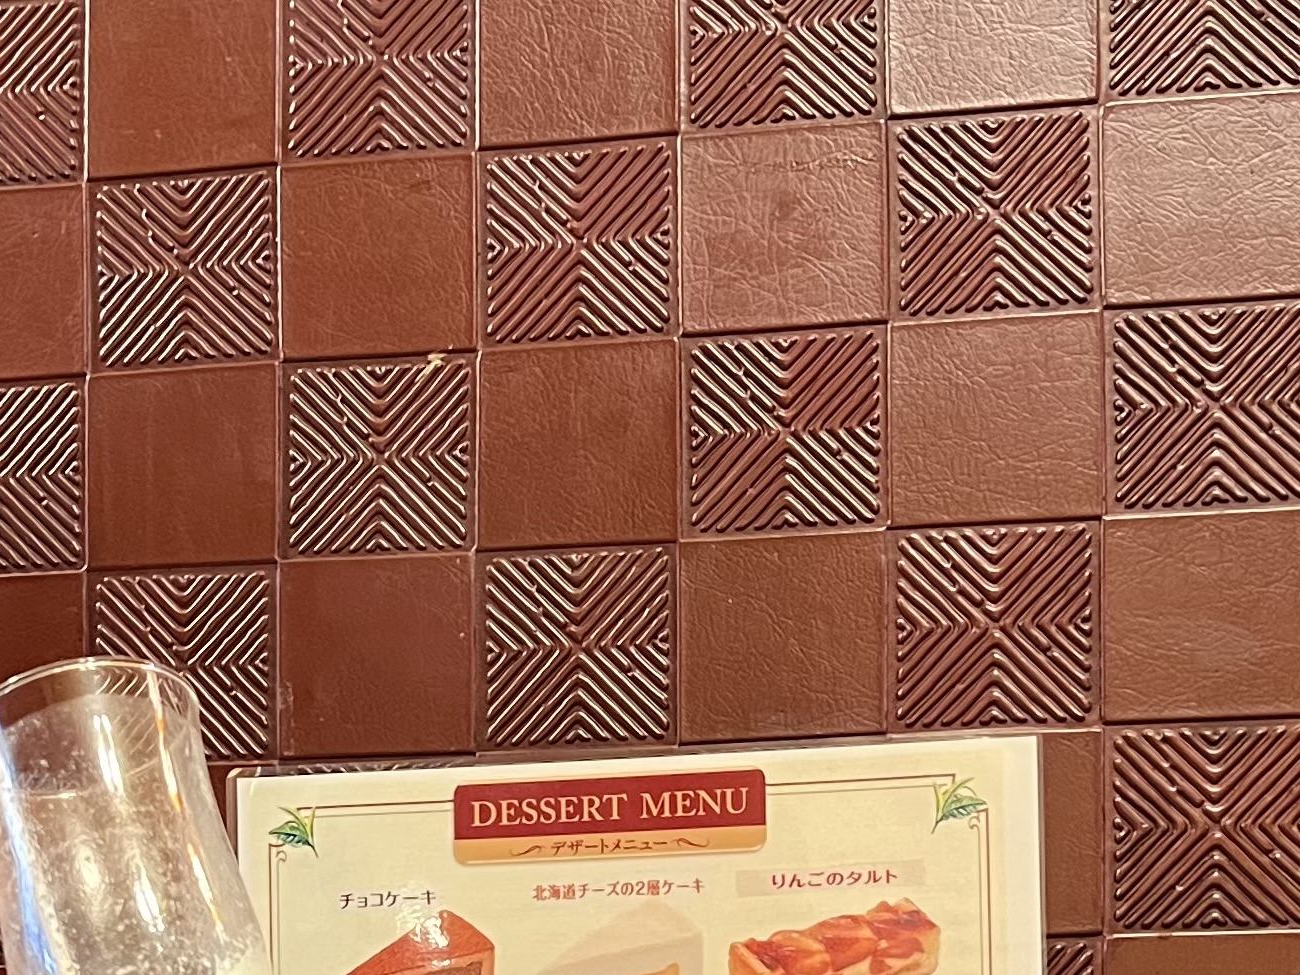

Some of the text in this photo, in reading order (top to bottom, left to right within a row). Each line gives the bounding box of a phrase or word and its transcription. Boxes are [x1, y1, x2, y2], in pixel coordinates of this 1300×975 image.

[471, 787, 748, 827] DESSERT MENU
[551, 838, 668, 856] デザートメニュー
[772, 869, 898, 889] りんごのタルト
[339, 889, 436, 909] チョコケーキ
[532, 878, 704, 901] 北海道チーズの2層ケーキ
